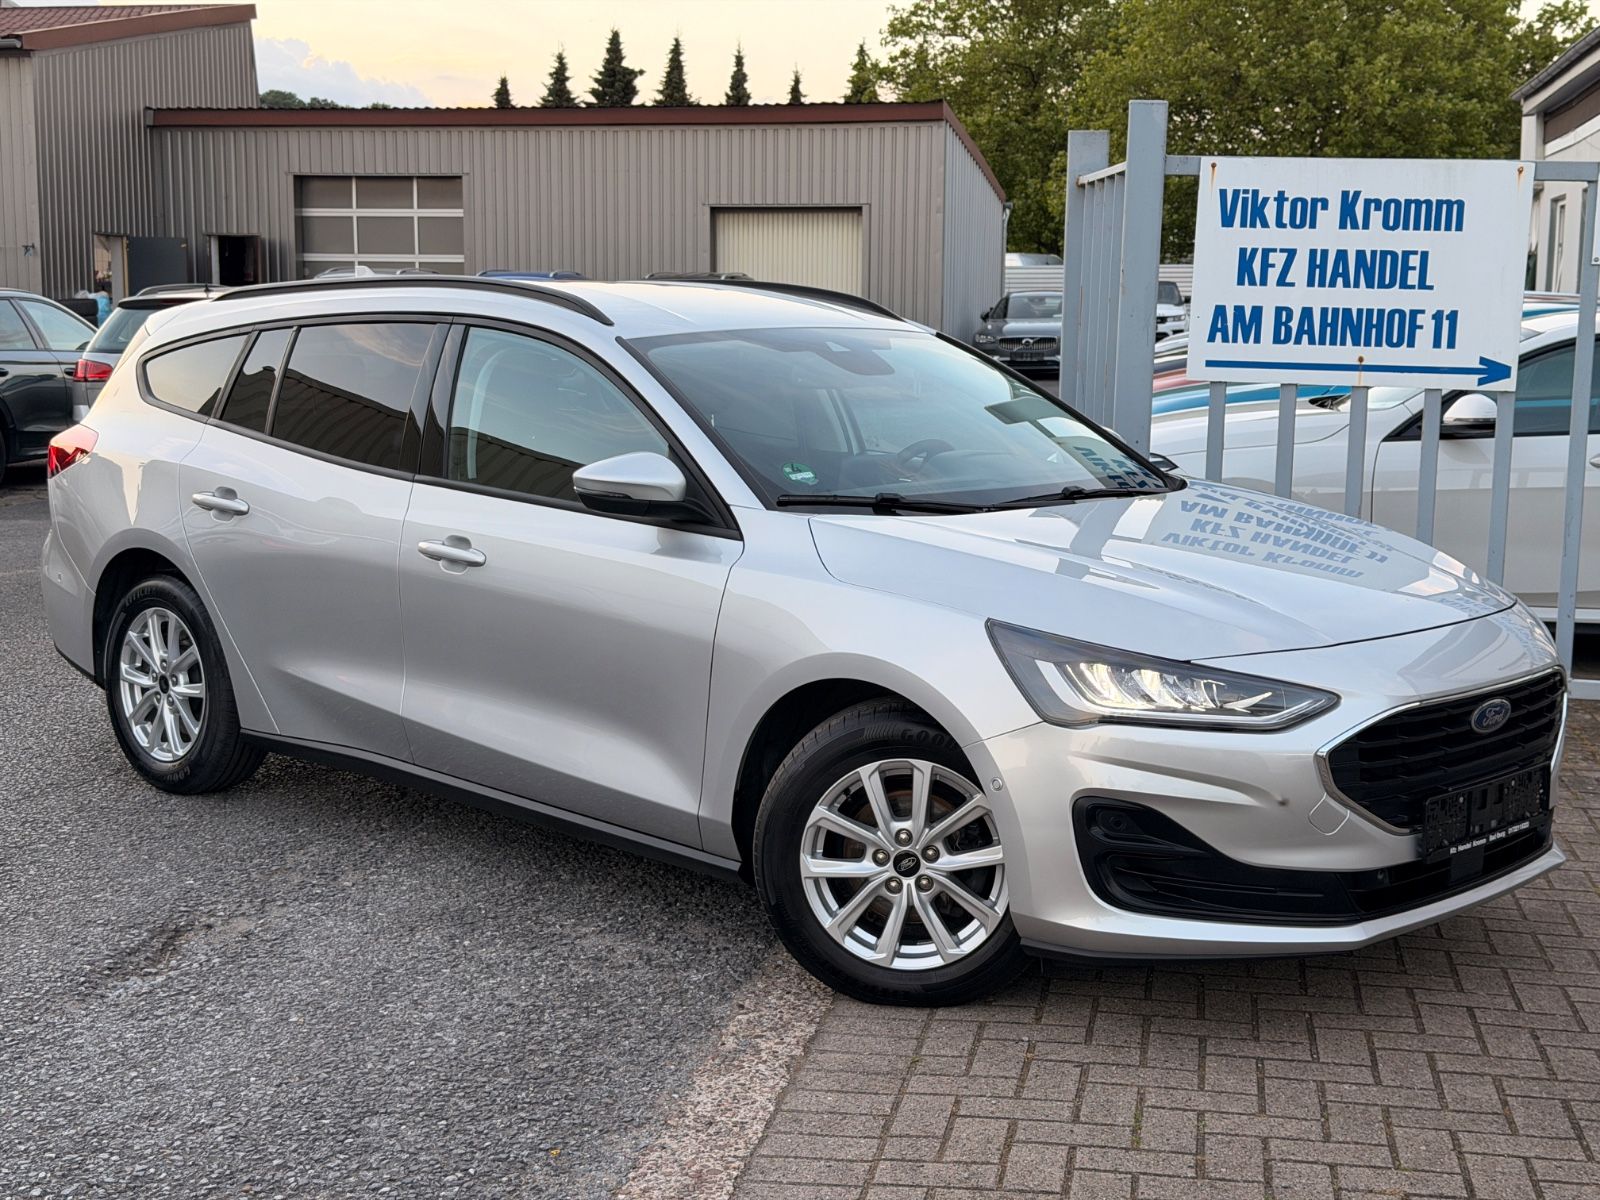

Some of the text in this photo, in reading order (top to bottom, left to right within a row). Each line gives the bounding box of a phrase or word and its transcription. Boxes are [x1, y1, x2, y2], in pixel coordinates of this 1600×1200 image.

[1219, 188, 1465, 232] Viktor Kromm
[1236, 247, 1434, 291] KFZ HANDEL
[1207, 304, 1459, 350] AM BAHNHOF 11
